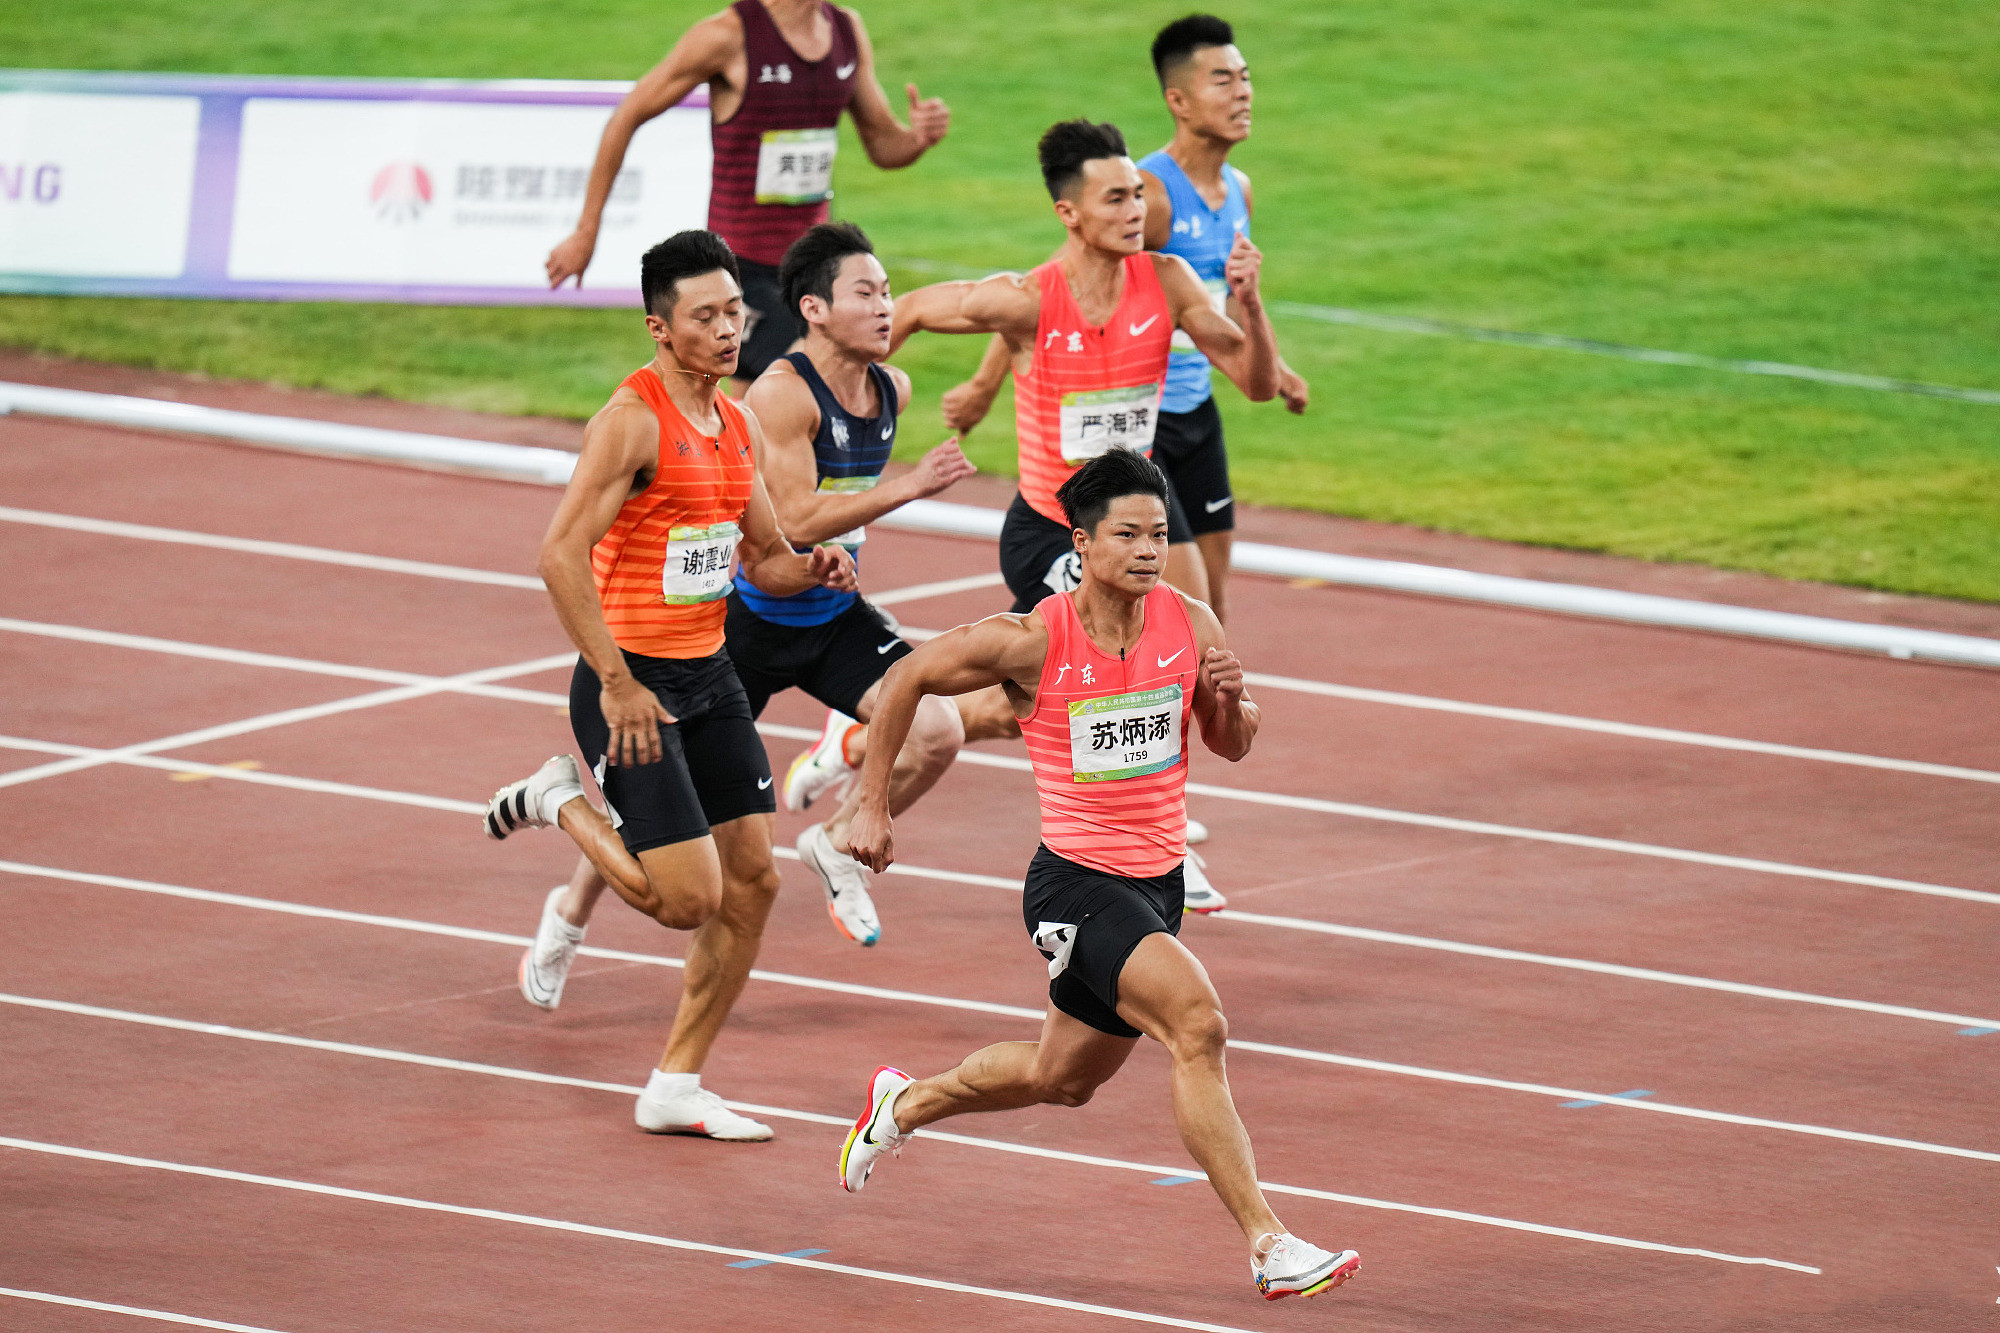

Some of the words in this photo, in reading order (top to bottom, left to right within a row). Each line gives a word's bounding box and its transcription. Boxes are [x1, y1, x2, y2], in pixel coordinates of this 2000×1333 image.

[1044, 328, 1084, 352] 广东
[682, 544, 734, 576] 谢震业
[1054, 662, 1096, 685] 广东
[1090, 711, 1171, 750] 苏炳添
[1124, 750, 1148, 763] 1759
